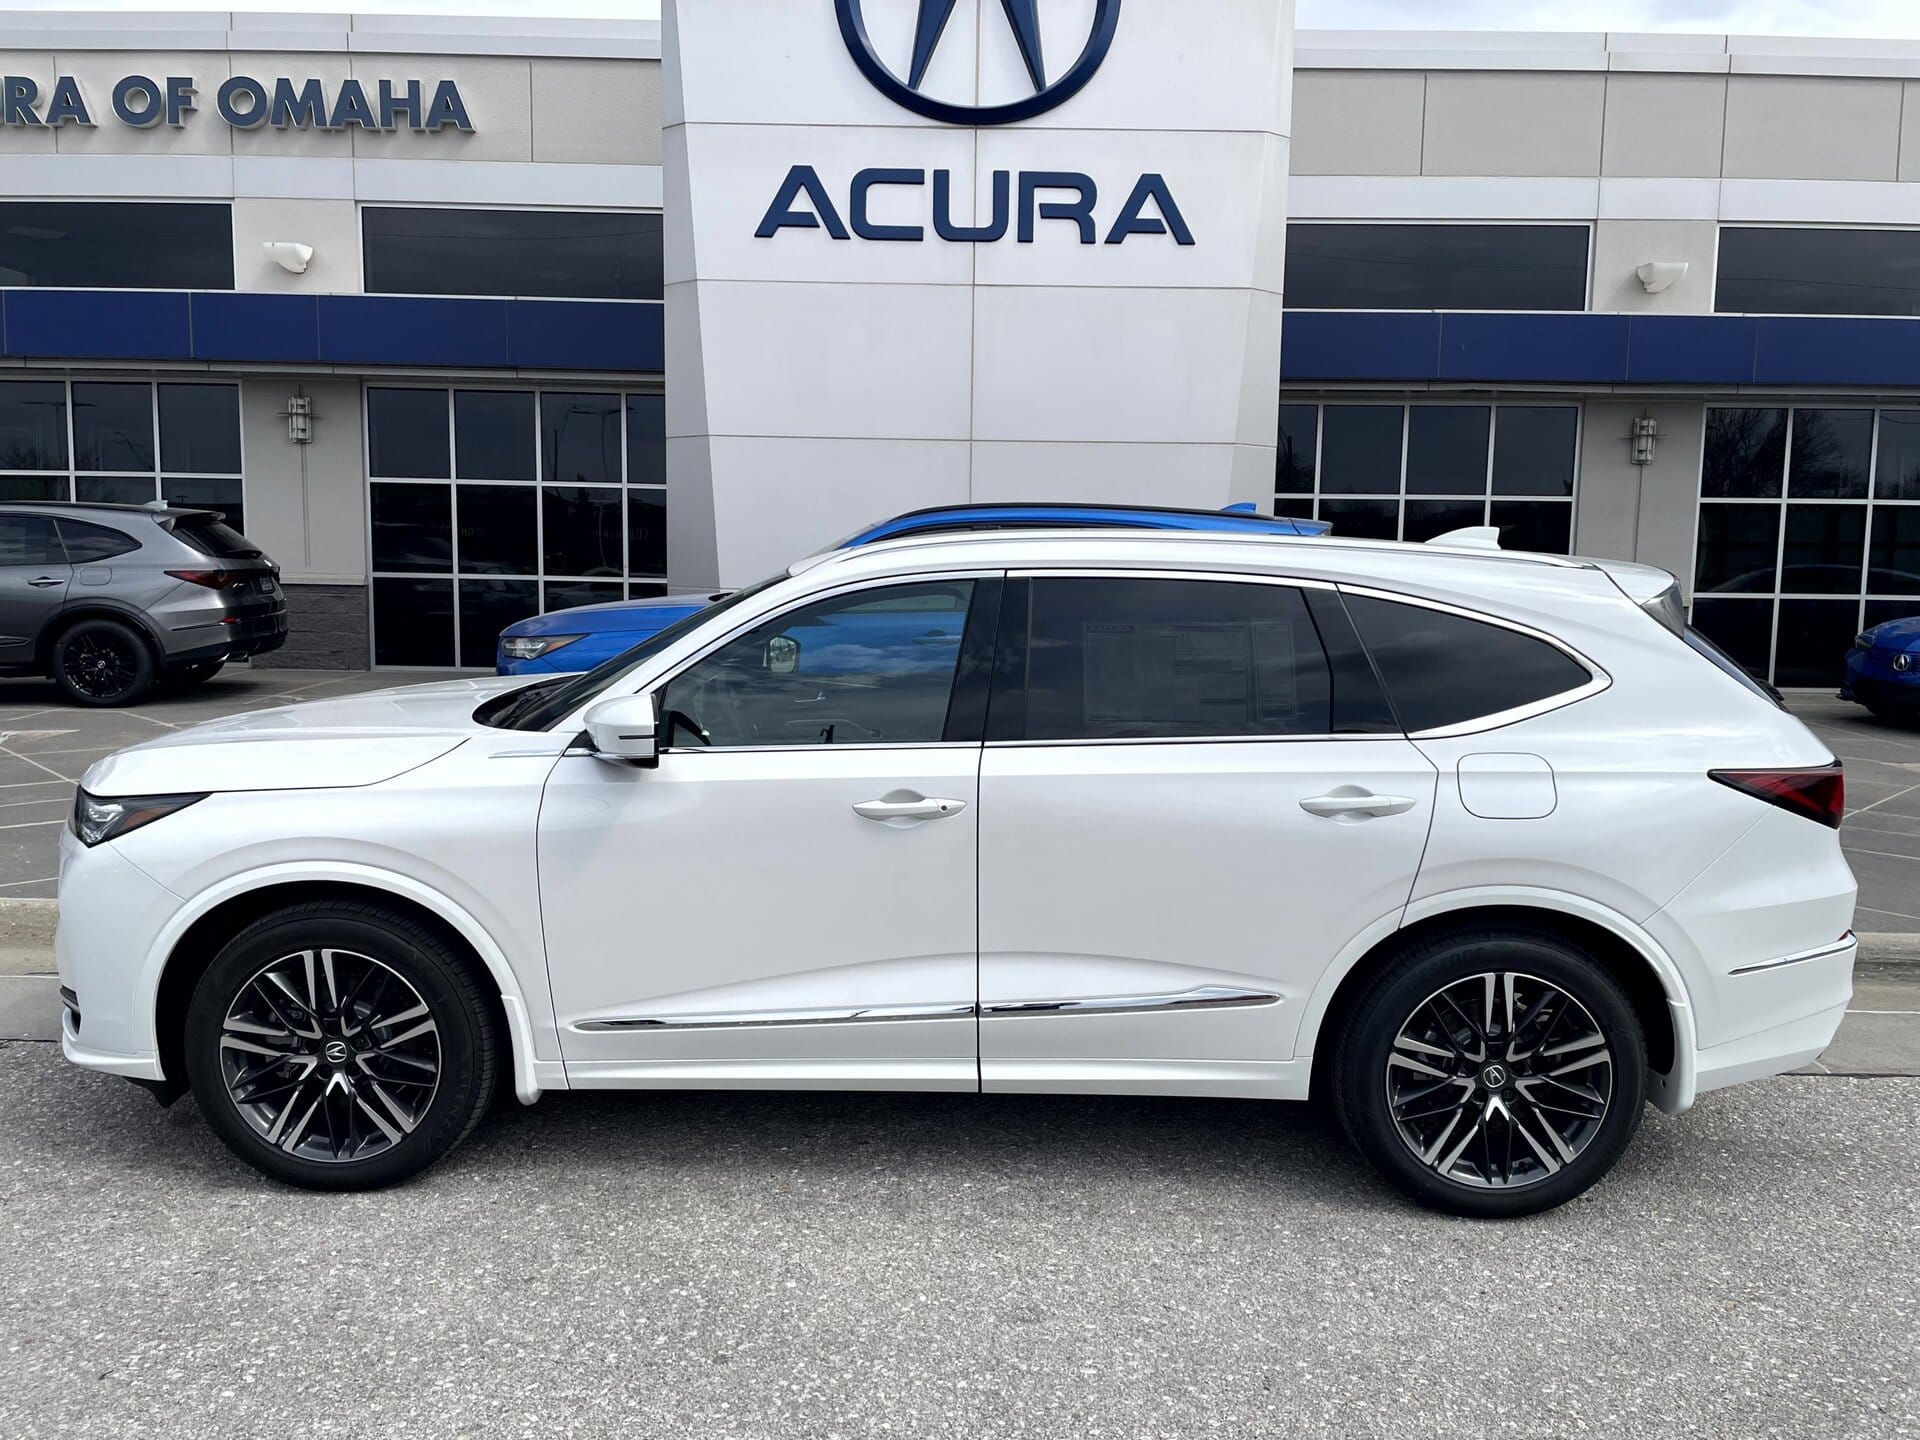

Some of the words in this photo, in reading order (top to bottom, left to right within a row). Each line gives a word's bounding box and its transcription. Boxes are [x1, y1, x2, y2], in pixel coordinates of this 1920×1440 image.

[0, 75, 96, 127] RA
[111, 74, 197, 128] OF
[216, 75, 474, 132] OMAHA
[754, 165, 1196, 245] ACURA
